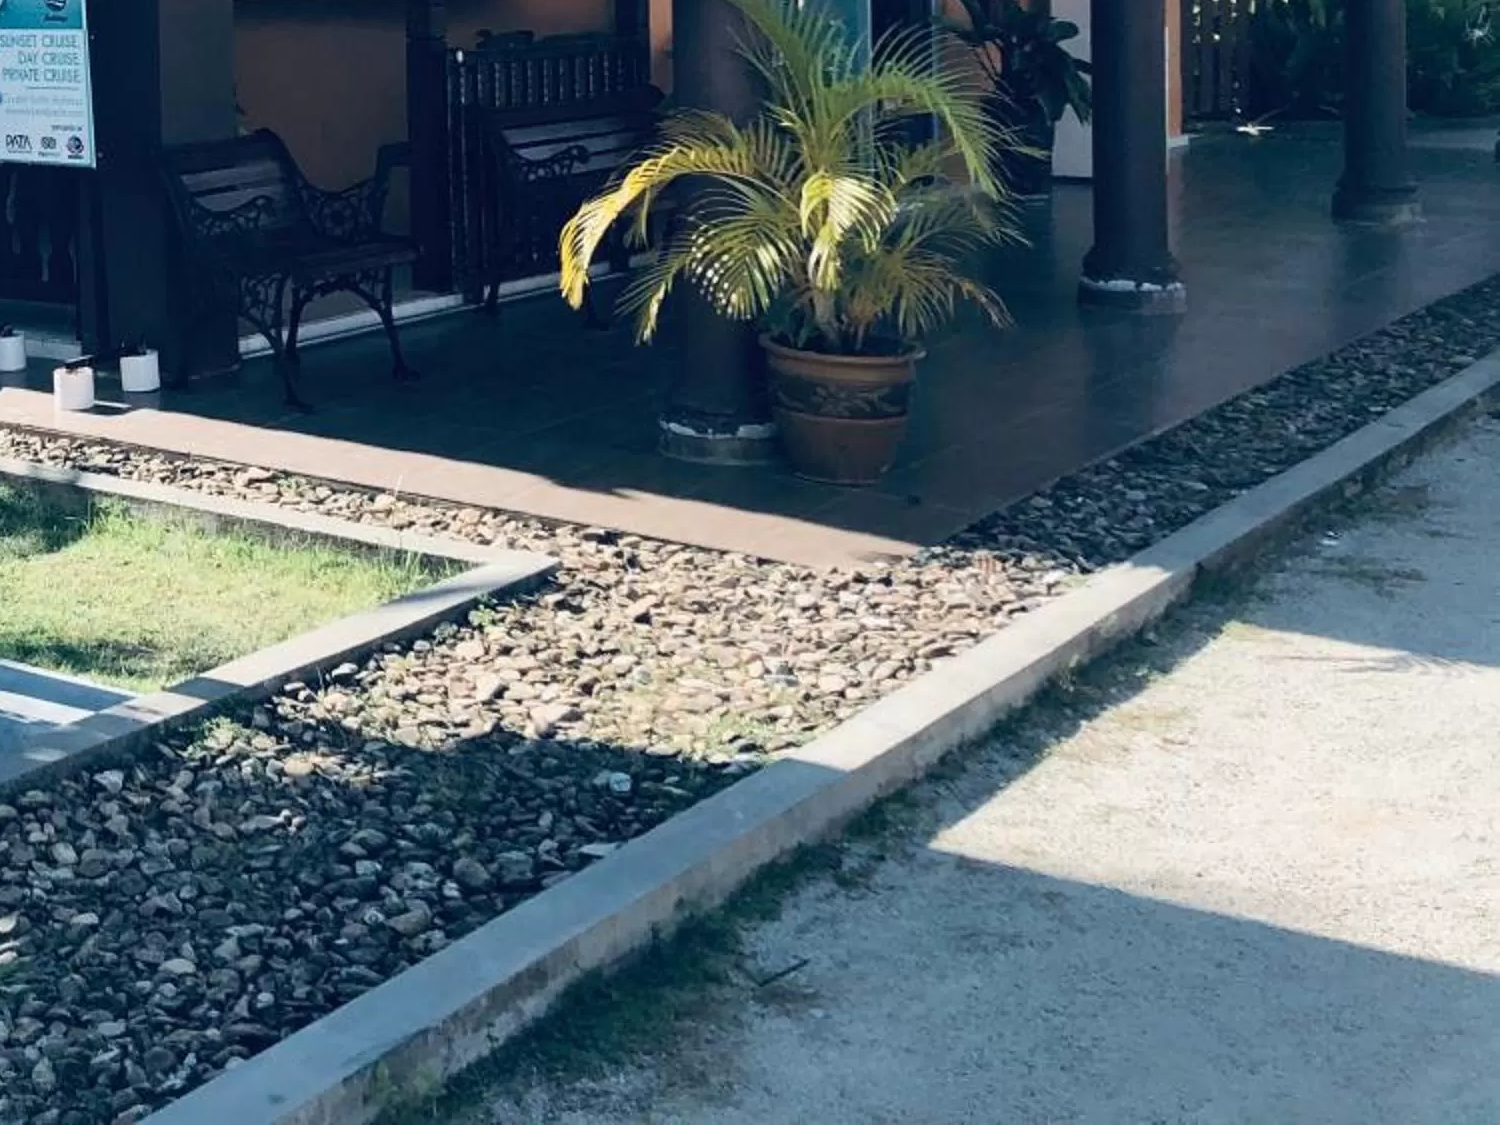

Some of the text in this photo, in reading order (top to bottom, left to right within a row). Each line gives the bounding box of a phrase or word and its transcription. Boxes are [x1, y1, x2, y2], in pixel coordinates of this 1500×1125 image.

[0, 34, 37, 48] SUNSET
[17, 51, 39, 64] DAY
[2, 67, 40, 81] PRIVATE
[5, 134, 33, 151] PATA
